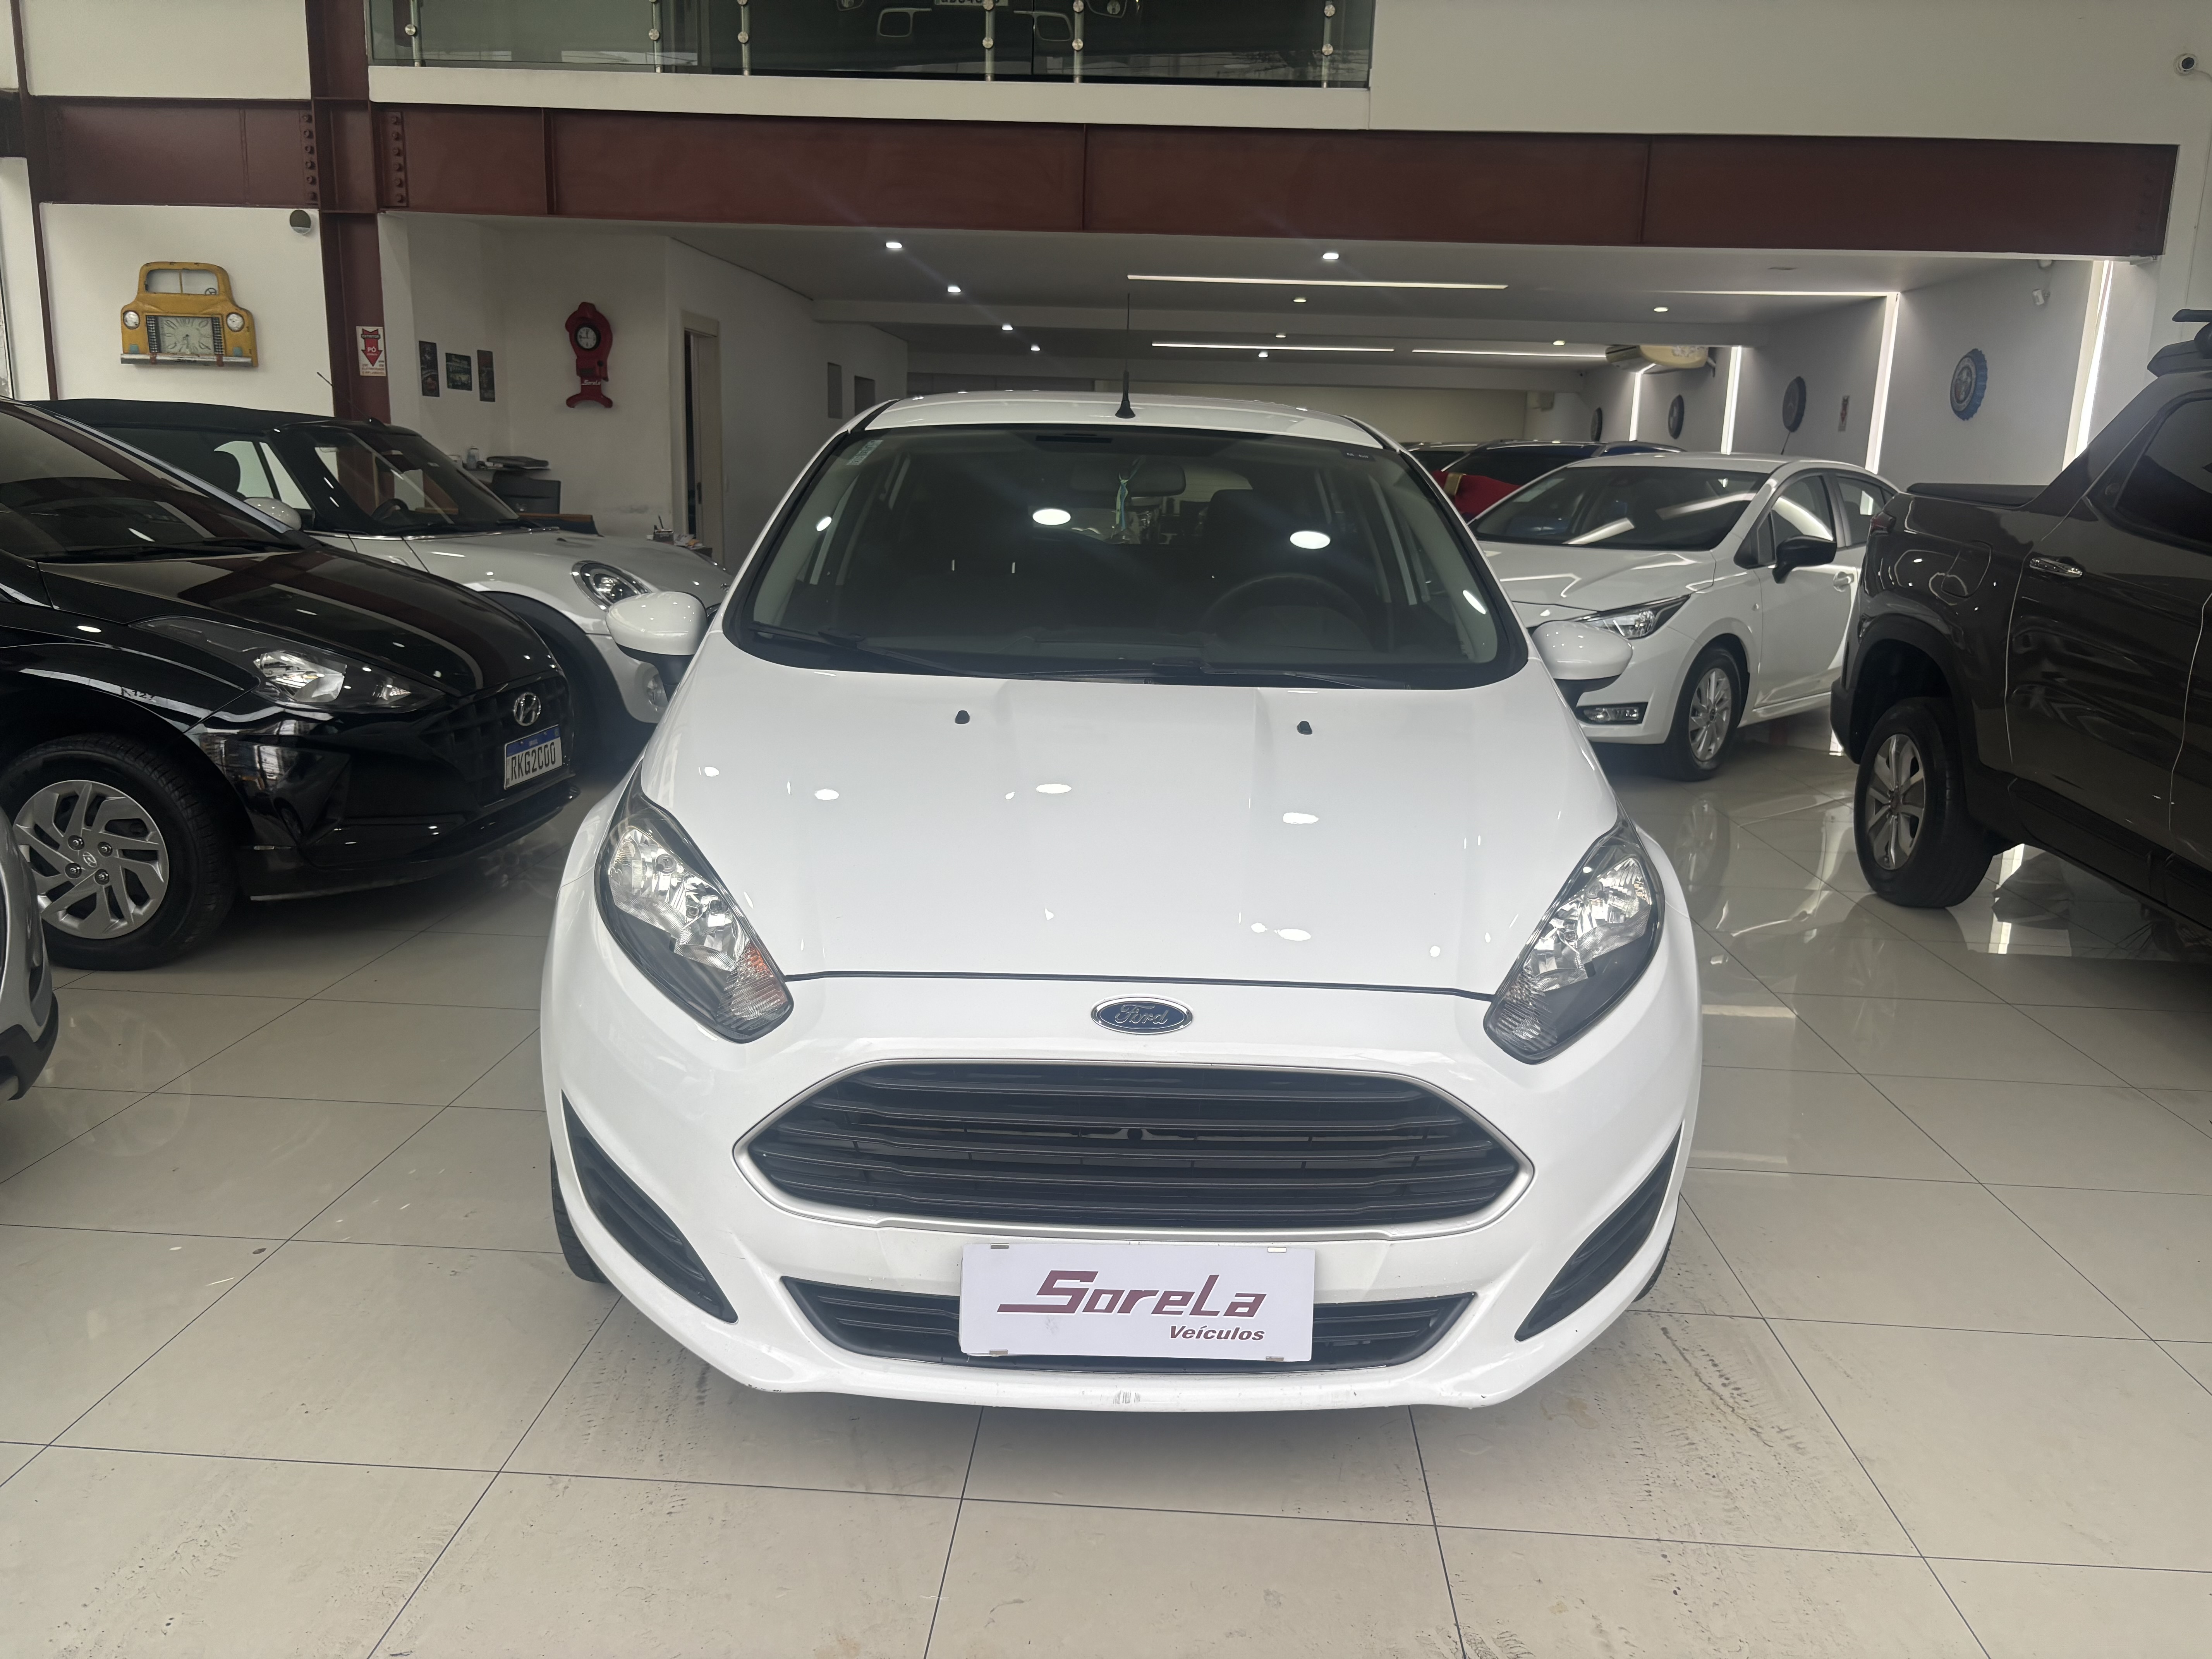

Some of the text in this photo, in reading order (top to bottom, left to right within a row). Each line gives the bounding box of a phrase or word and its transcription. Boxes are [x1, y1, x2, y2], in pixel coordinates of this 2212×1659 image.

[511, 742, 556, 781] RKG2C00
[1115, 1004, 1168, 1024] Ford
[1170, 1325, 1265, 1341] Veículos
